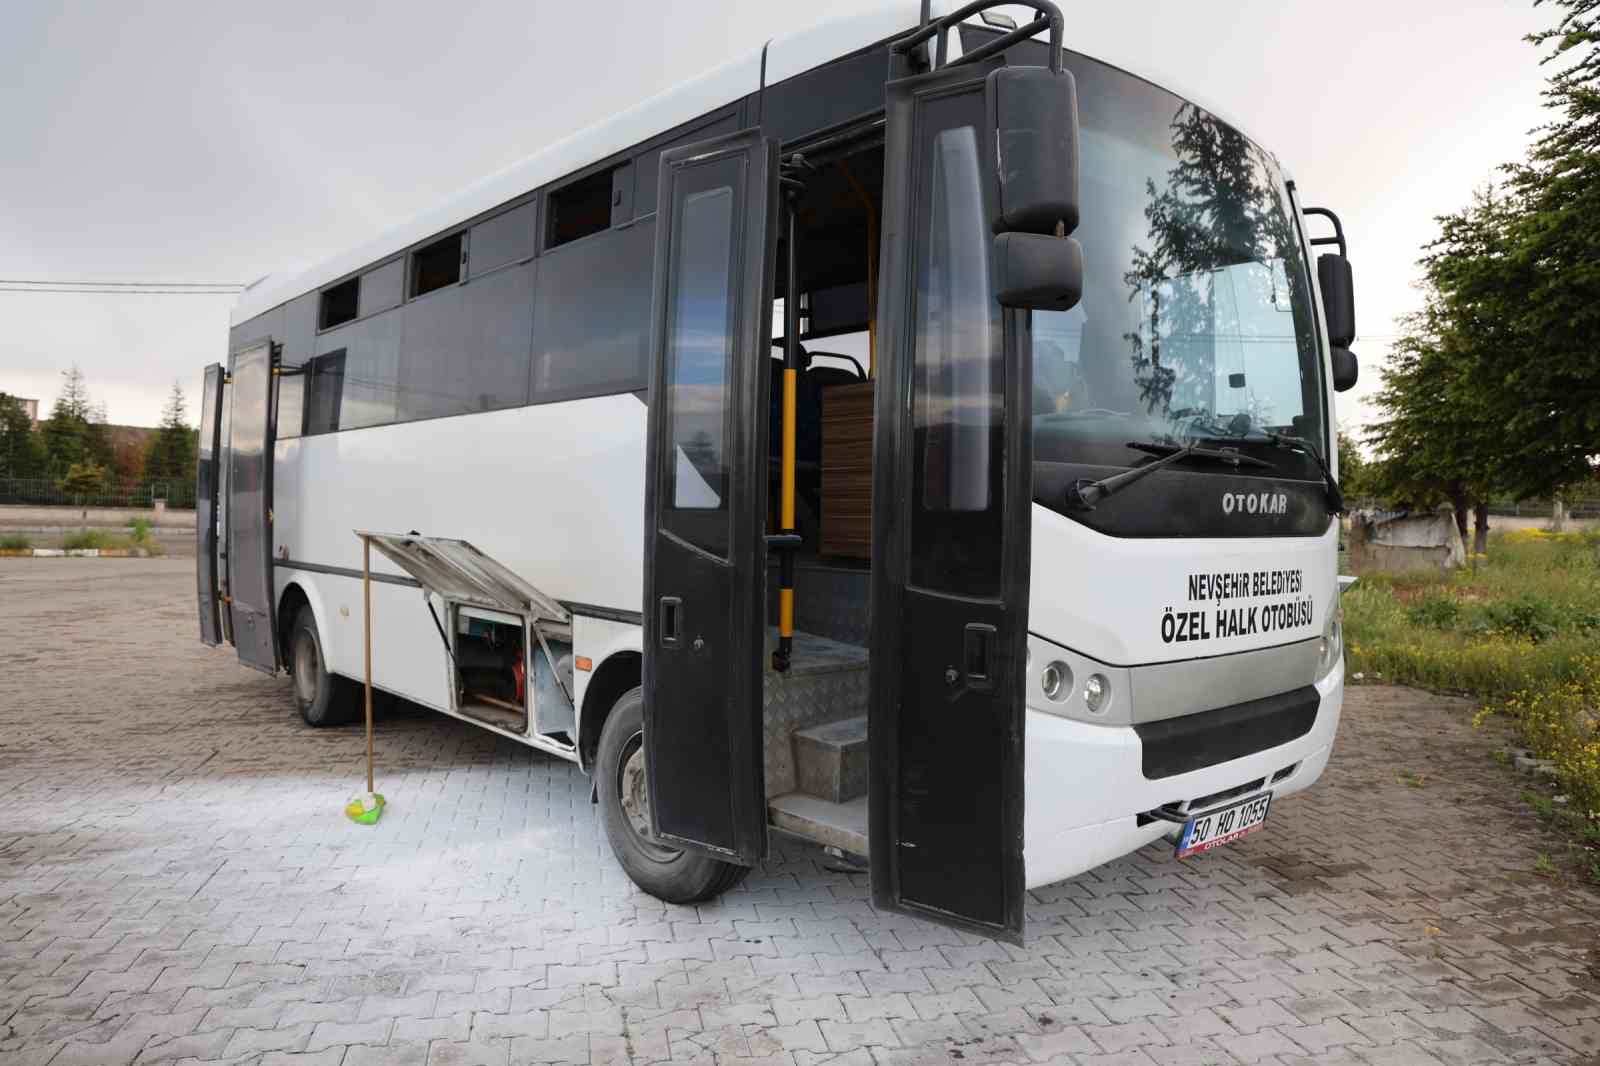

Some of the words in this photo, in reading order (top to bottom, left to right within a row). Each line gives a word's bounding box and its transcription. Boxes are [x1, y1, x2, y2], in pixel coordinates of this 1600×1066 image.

[1222, 493, 1287, 514] OTOKAR
[1161, 606, 1210, 643] ÖZEL
[1216, 606, 1257, 638] HALK
[1261, 594, 1313, 632] OTOBÜSÜ
[1190, 817, 1211, 844] 50
[1237, 798, 1267, 829] 1055
